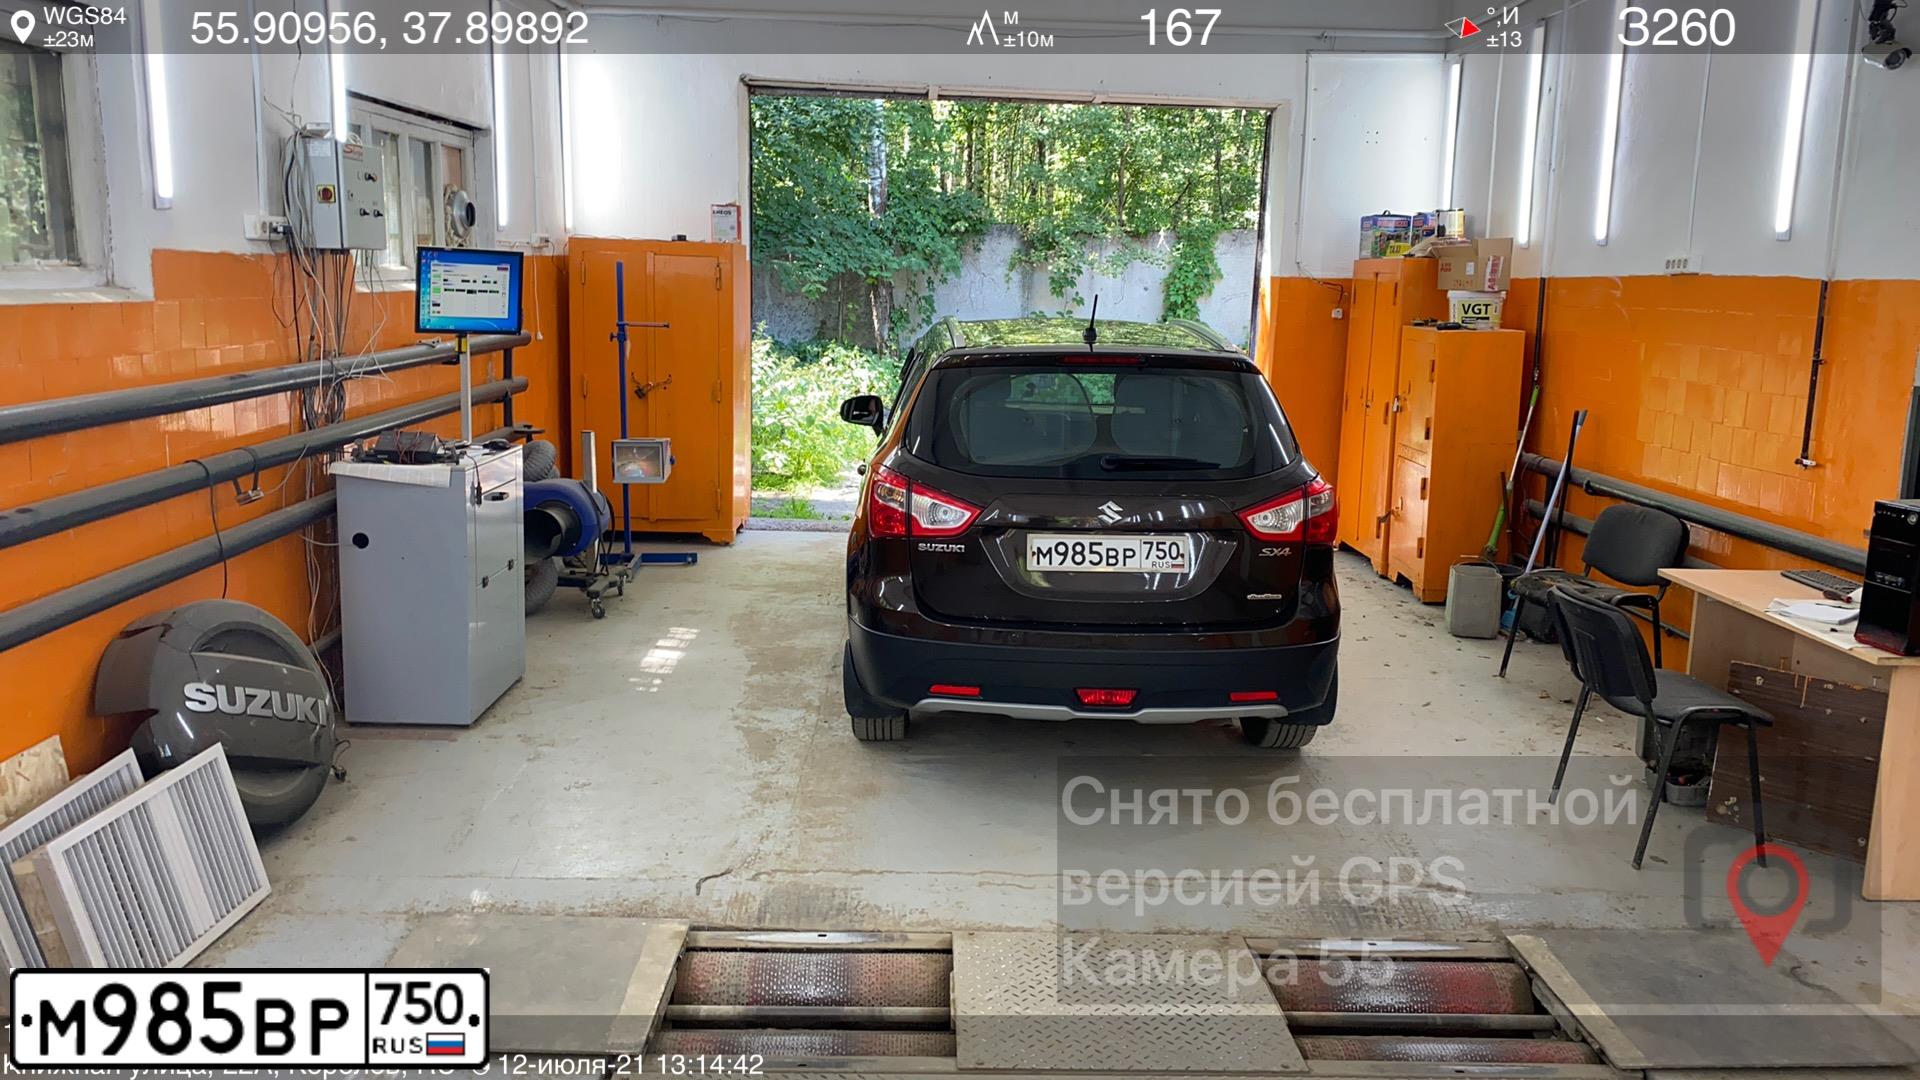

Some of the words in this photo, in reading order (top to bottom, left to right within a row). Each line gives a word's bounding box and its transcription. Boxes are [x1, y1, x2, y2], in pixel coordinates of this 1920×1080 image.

[1461, 303, 1491, 315] VGT
[918, 542, 966, 553] SUZUKI
[1142, 541, 1181, 561] 750
[1258, 547, 1292, 557] SX4
[1151, 561, 1172, 569] RUS
[183, 681, 327, 726] SUZUKI
